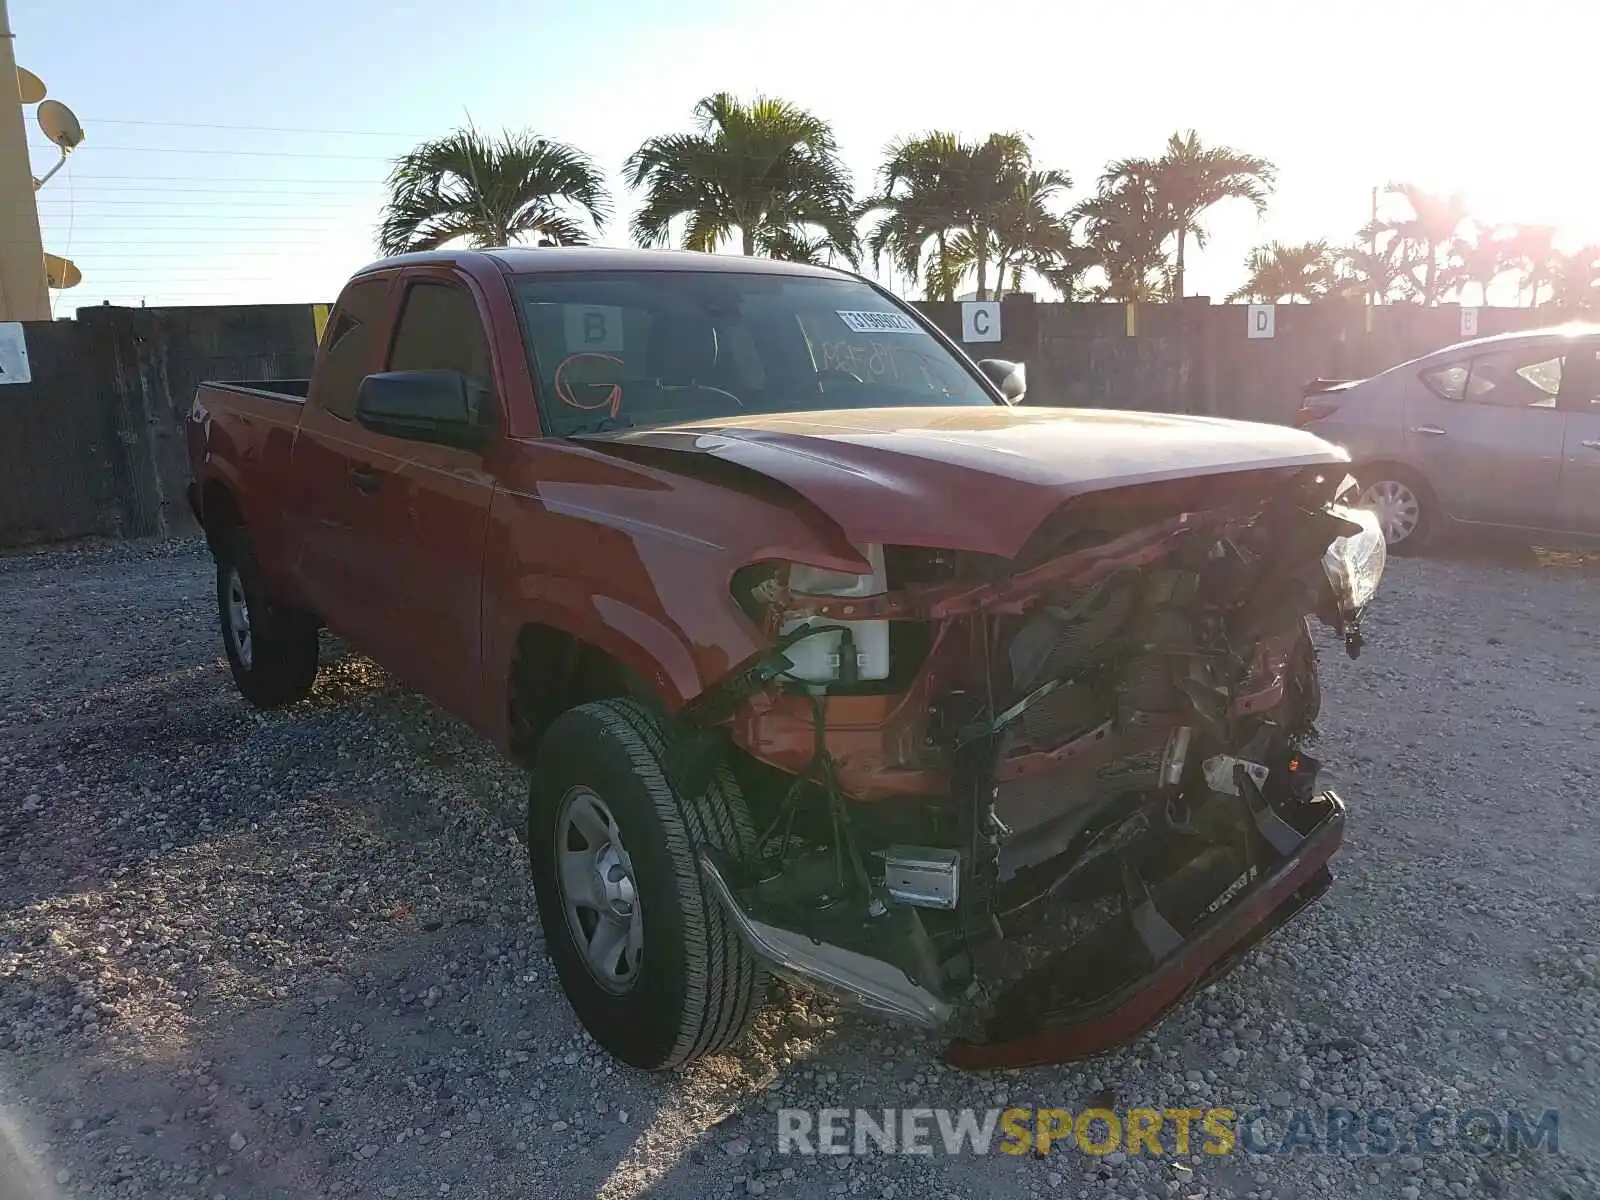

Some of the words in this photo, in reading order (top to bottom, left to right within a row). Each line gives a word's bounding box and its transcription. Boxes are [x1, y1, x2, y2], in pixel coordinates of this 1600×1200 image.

[584, 312, 608, 344] B
[974, 310, 989, 335] C
[1257, 311, 1268, 331] D
[555, 352, 625, 418] G
